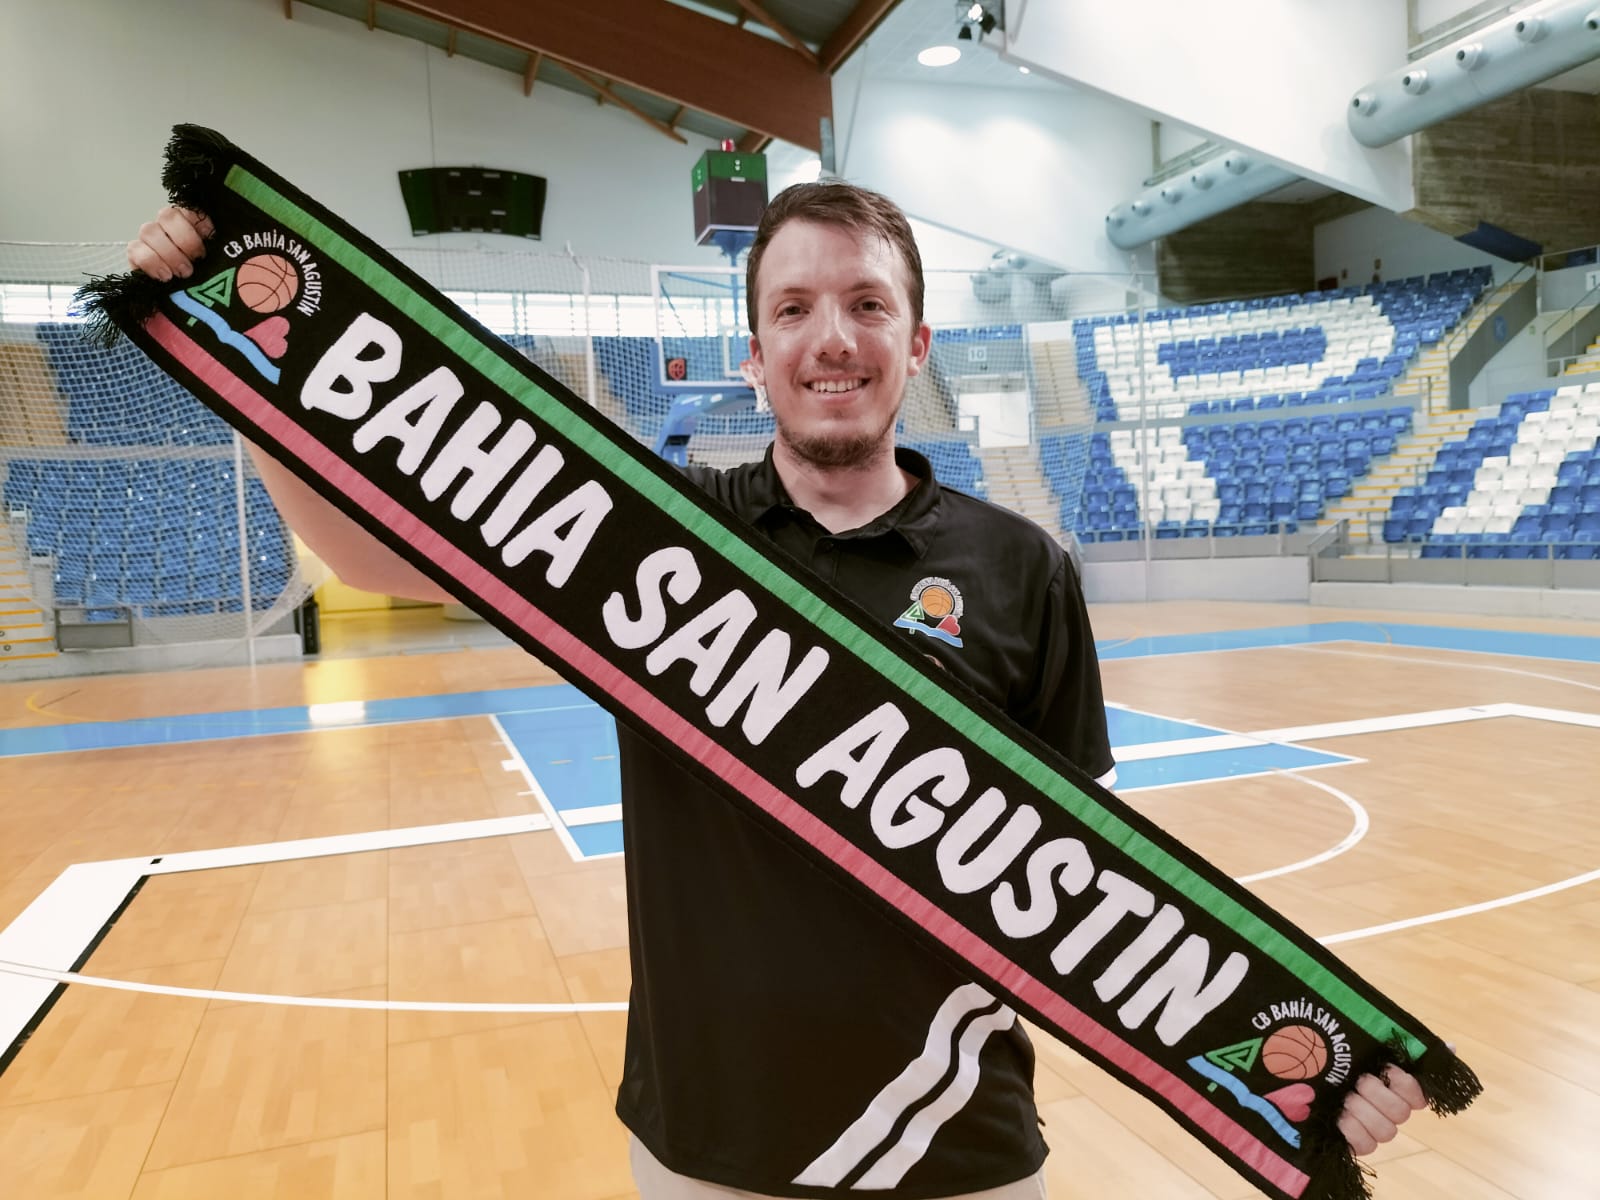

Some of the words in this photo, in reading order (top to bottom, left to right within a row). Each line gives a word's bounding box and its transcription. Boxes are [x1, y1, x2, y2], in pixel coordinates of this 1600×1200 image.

[223, 240, 244, 258] CB
[286, 239, 312, 264] SAN
[970, 349, 985, 360] 10
[300, 312, 614, 589] BAHIA
[602, 546, 829, 746] SAN
[795, 701, 1250, 1048] AGUSTIN
[1251, 1011, 1272, 1030] CB
[1313, 1007, 1340, 1035] SAN
